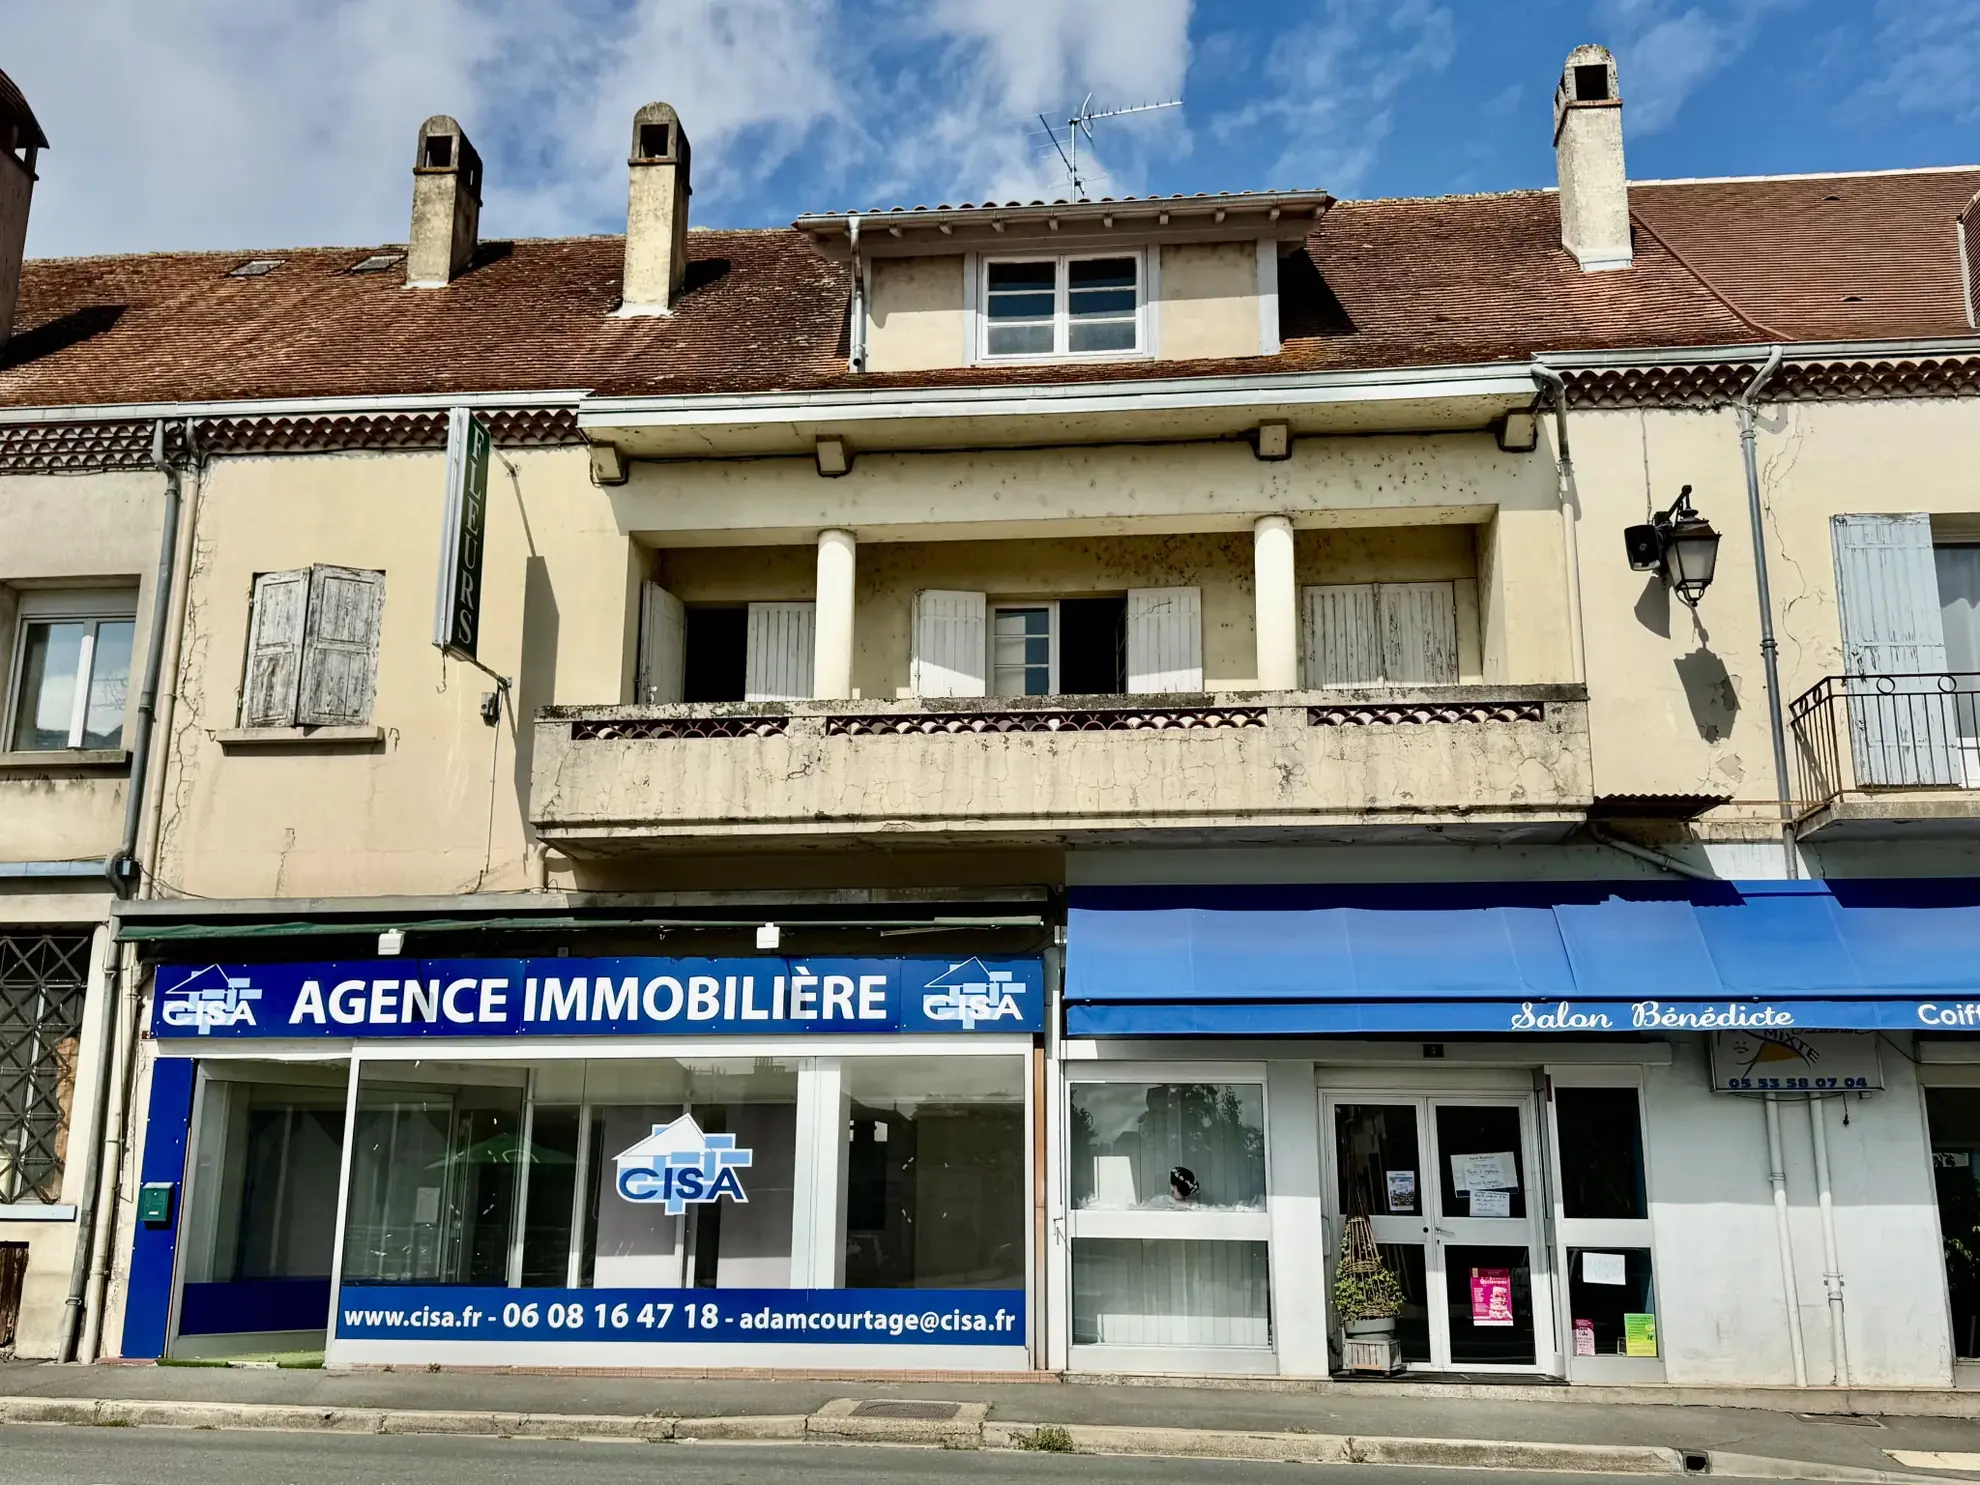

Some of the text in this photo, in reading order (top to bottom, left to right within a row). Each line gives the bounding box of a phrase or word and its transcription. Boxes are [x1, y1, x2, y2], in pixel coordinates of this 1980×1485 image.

[457, 424, 485, 645] FLEURS
[288, 966, 887, 1025] AGENCE IMMOBILIÈRE
[922, 994, 1024, 1021] CISA
[161, 1000, 257, 1026] CISA
[1511, 1001, 1795, 1030] Salon Bénédicte
[1728, 1077, 1752, 1089] 05
[1815, 1077, 1838, 1089] 07
[619, 1166, 745, 1200] CISA
[344, 1305, 482, 1328] www.cisa.fr
[503, 1302, 539, 1329] 06
[547, 1303, 584, 1329] 08
[595, 1303, 629, 1329] 16
[636, 1303, 674, 1329] 47
[684, 1303, 719, 1329] 18
[739, 1307, 1016, 1335] adamcourtage@cisa.fr
